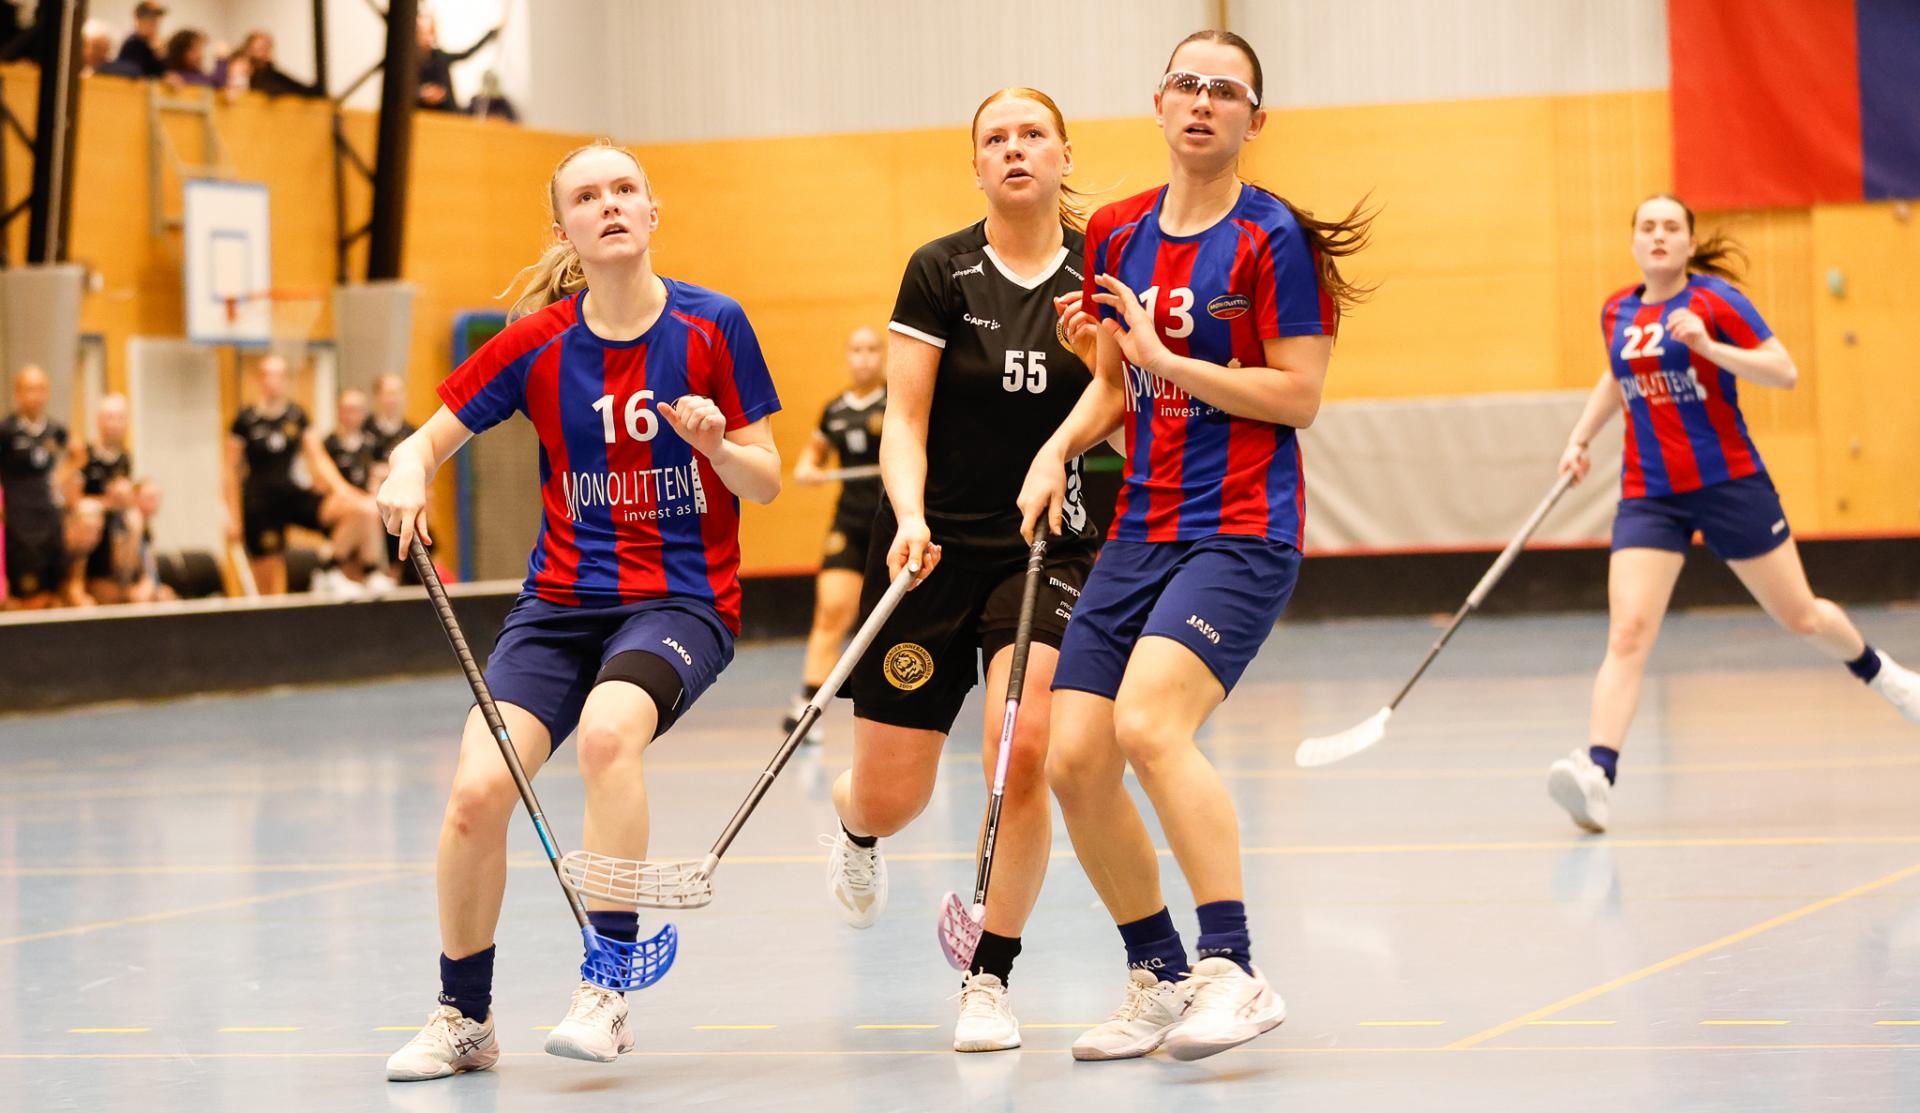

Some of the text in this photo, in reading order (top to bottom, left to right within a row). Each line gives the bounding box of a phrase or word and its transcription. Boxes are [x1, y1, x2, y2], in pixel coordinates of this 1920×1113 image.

[1139, 286, 1195, 339] 13
[1620, 322, 1666, 360] 22
[1002, 349, 1048, 394] 55
[592, 389, 659, 444] 16
[1160, 404, 1200, 417] invest
[562, 464, 690, 523] MONOLITTEN
[624, 504, 691, 522] invest as
[1186, 614, 1220, 644] JAKO
[661, 636, 692, 666] JAKO
